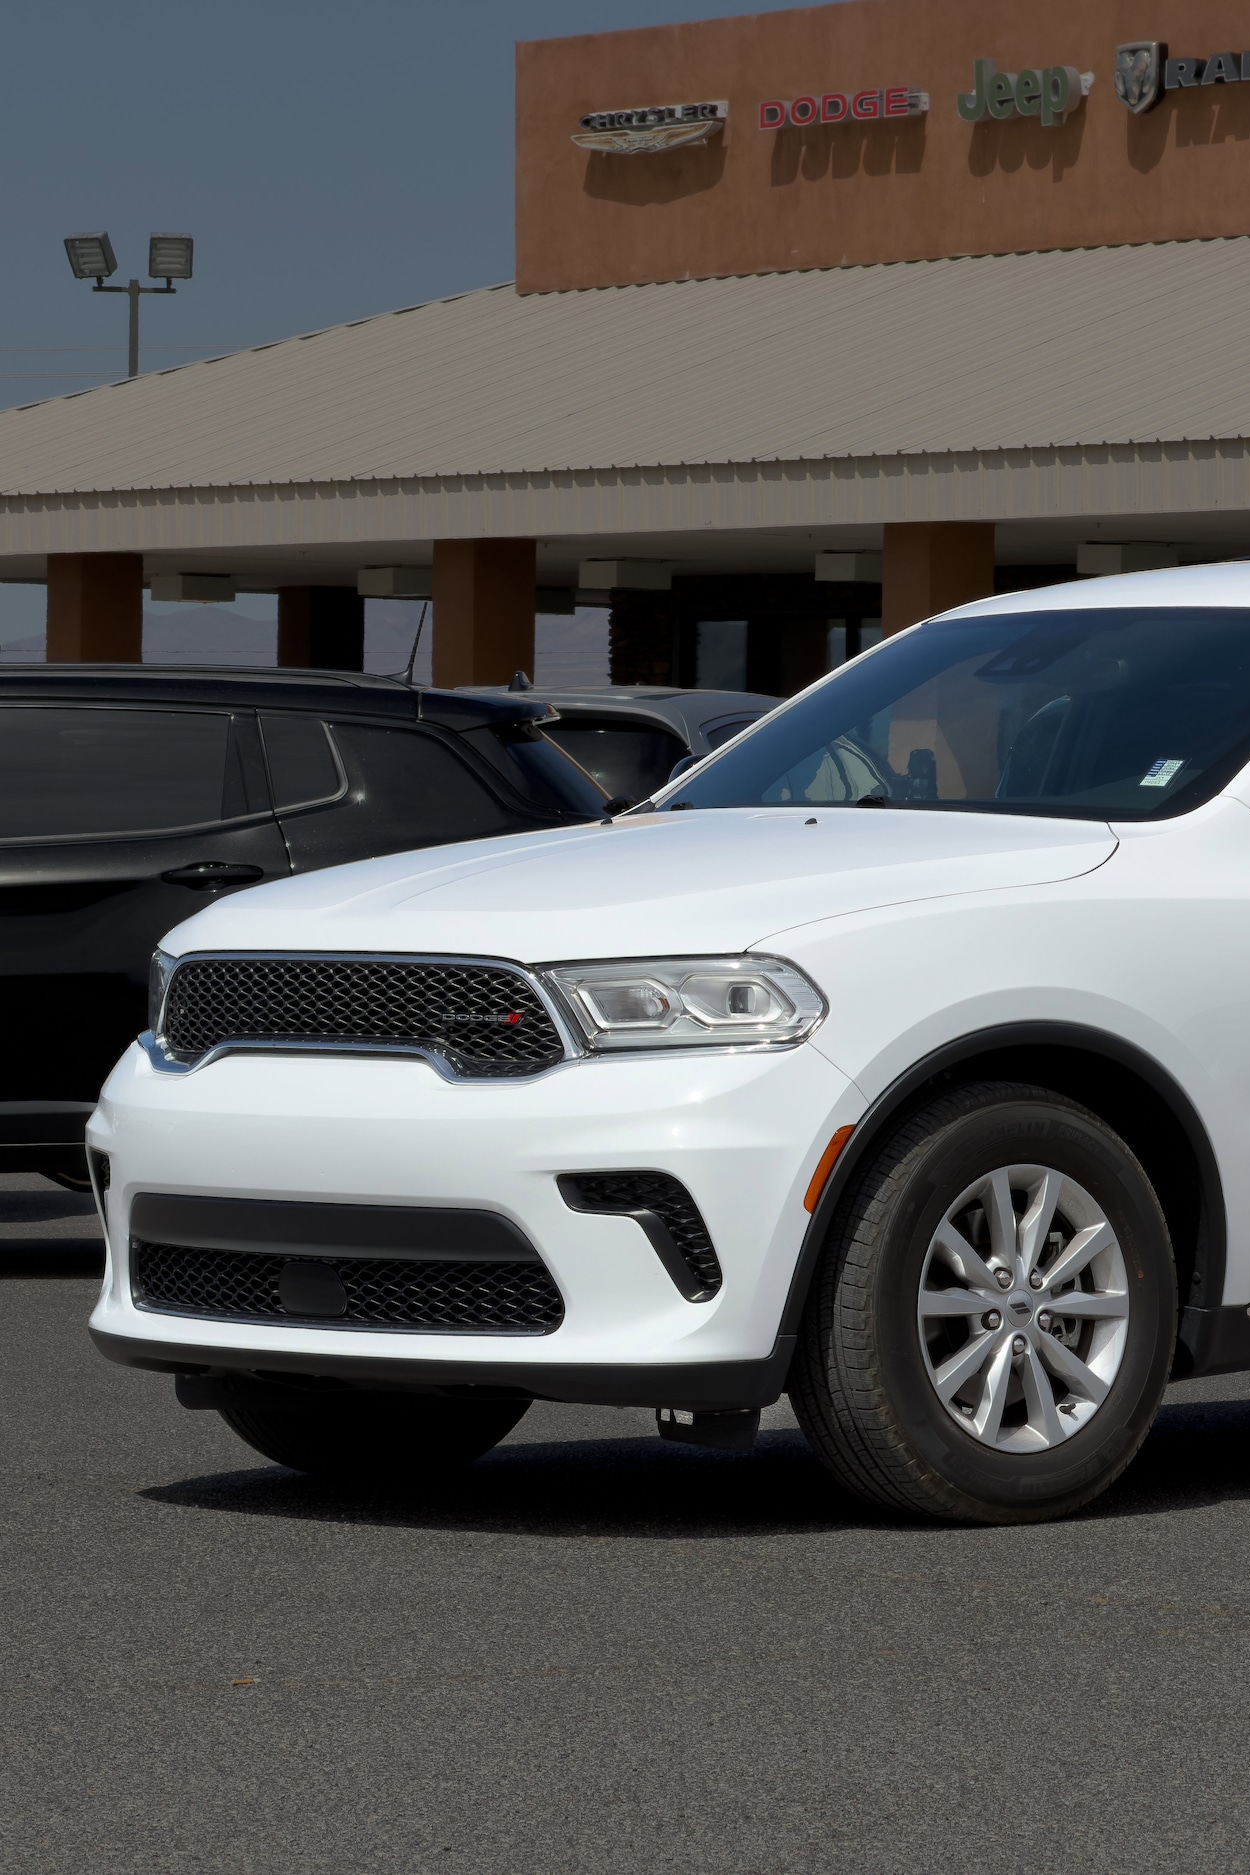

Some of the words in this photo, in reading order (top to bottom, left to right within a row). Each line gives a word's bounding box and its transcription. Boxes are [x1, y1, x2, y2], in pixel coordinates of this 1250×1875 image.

[758, 86, 912, 131] DODGE
[957, 57, 1074, 127] Jeep
[577, 102, 722, 131] CHRYSLER
[442, 1013, 510, 1022] DODGE
